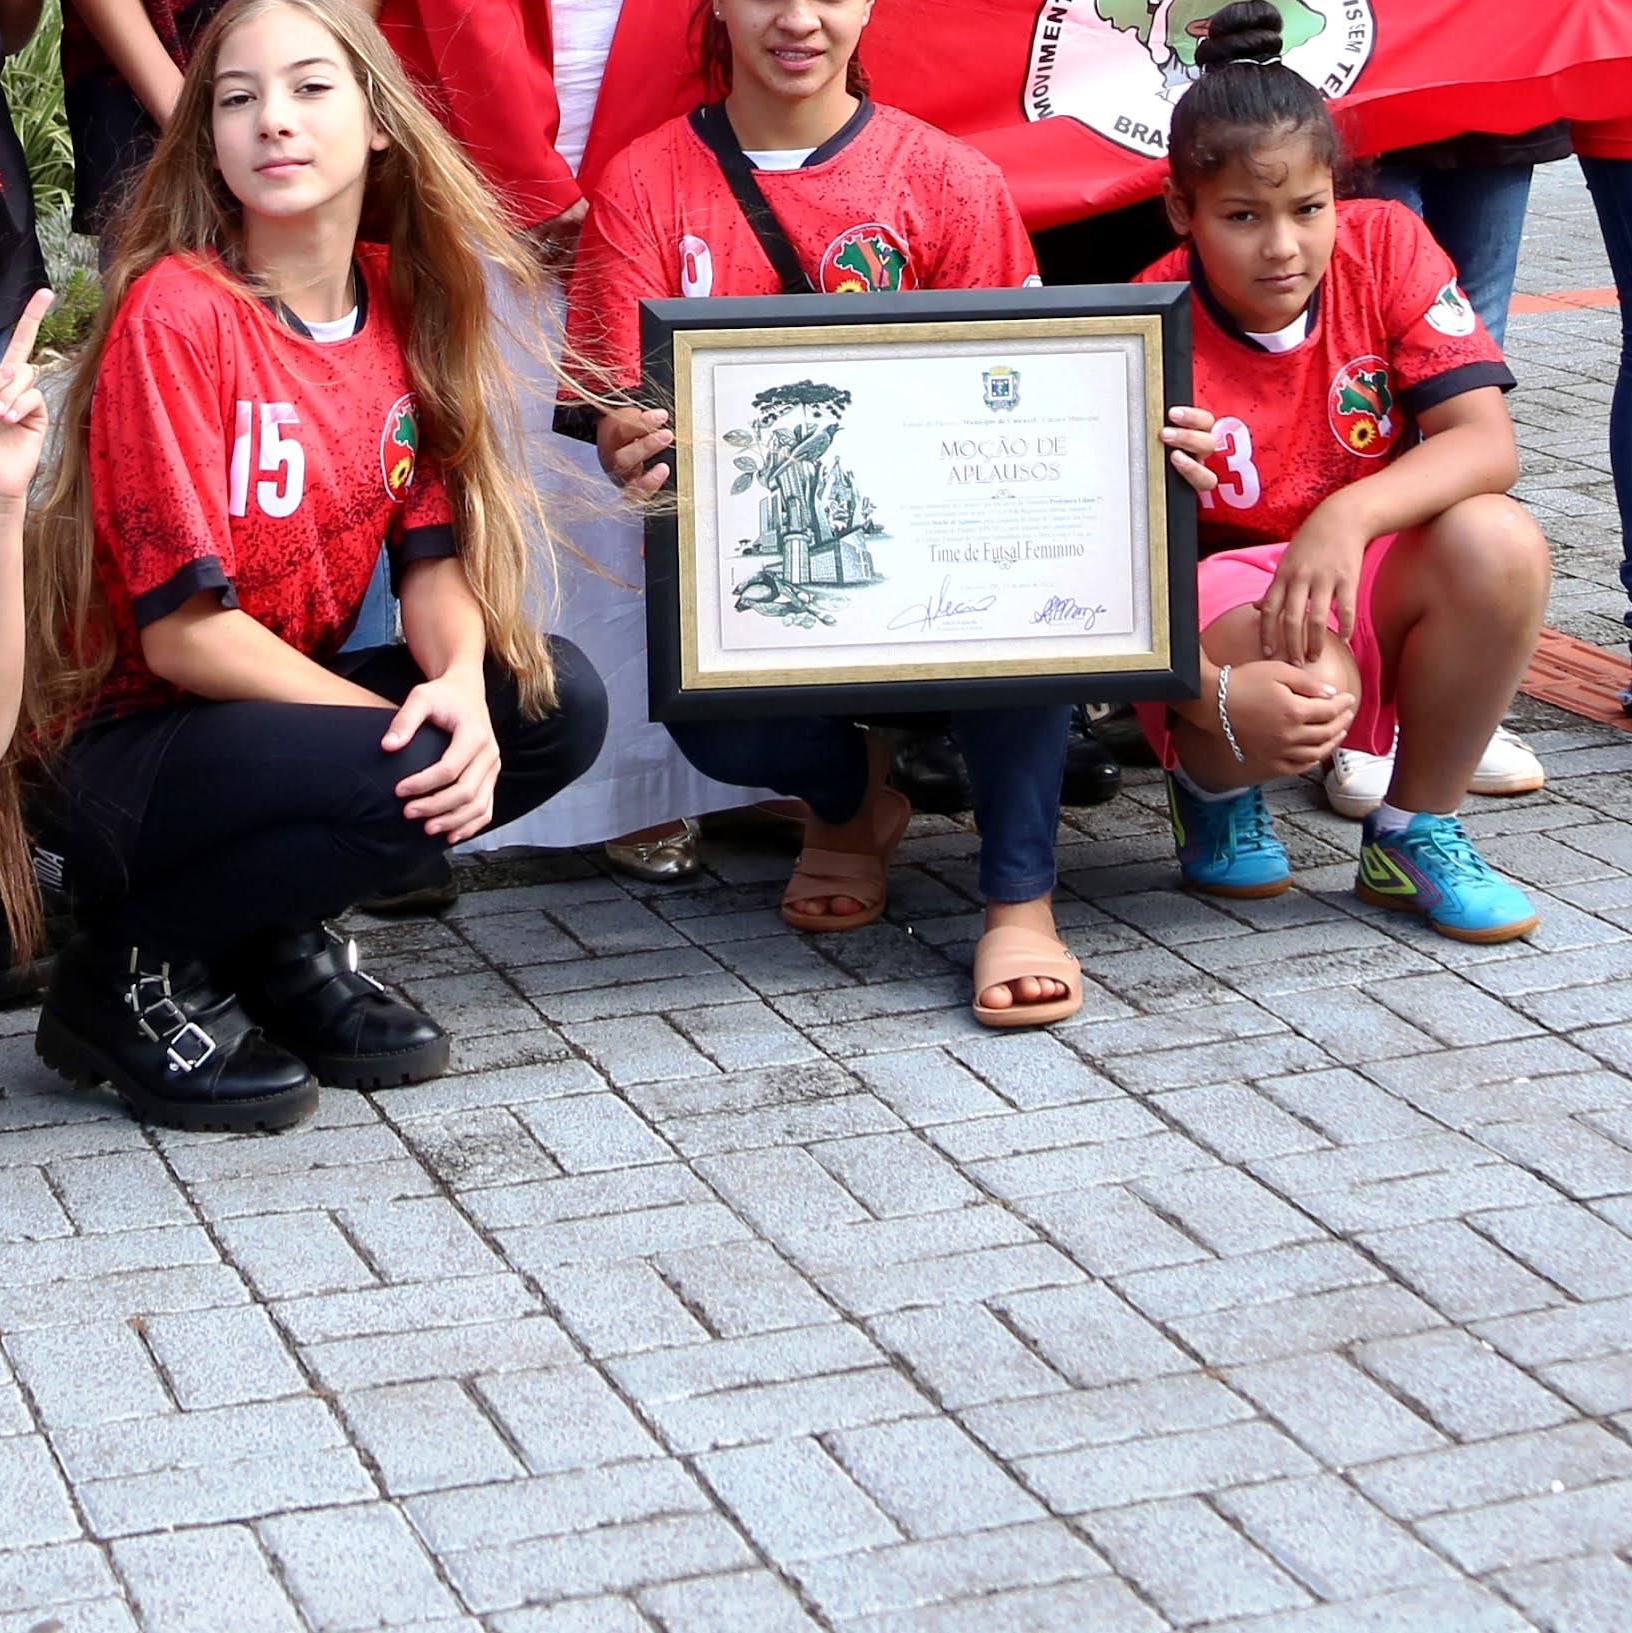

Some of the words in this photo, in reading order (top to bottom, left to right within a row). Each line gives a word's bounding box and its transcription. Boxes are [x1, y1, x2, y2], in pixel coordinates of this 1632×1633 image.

[1113, 115, 1170, 151] BRA
[229, 399, 306, 518] 15
[939, 435, 1029, 463] MOÇÃO
[1036, 435, 1068, 457] DE
[946, 461, 1062, 485] APLAUSOS
[928, 543, 961, 563] Time
[964, 543, 979, 562] de
[983, 541, 1021, 562] Futsal
[1025, 539, 1085, 560] Feminino
